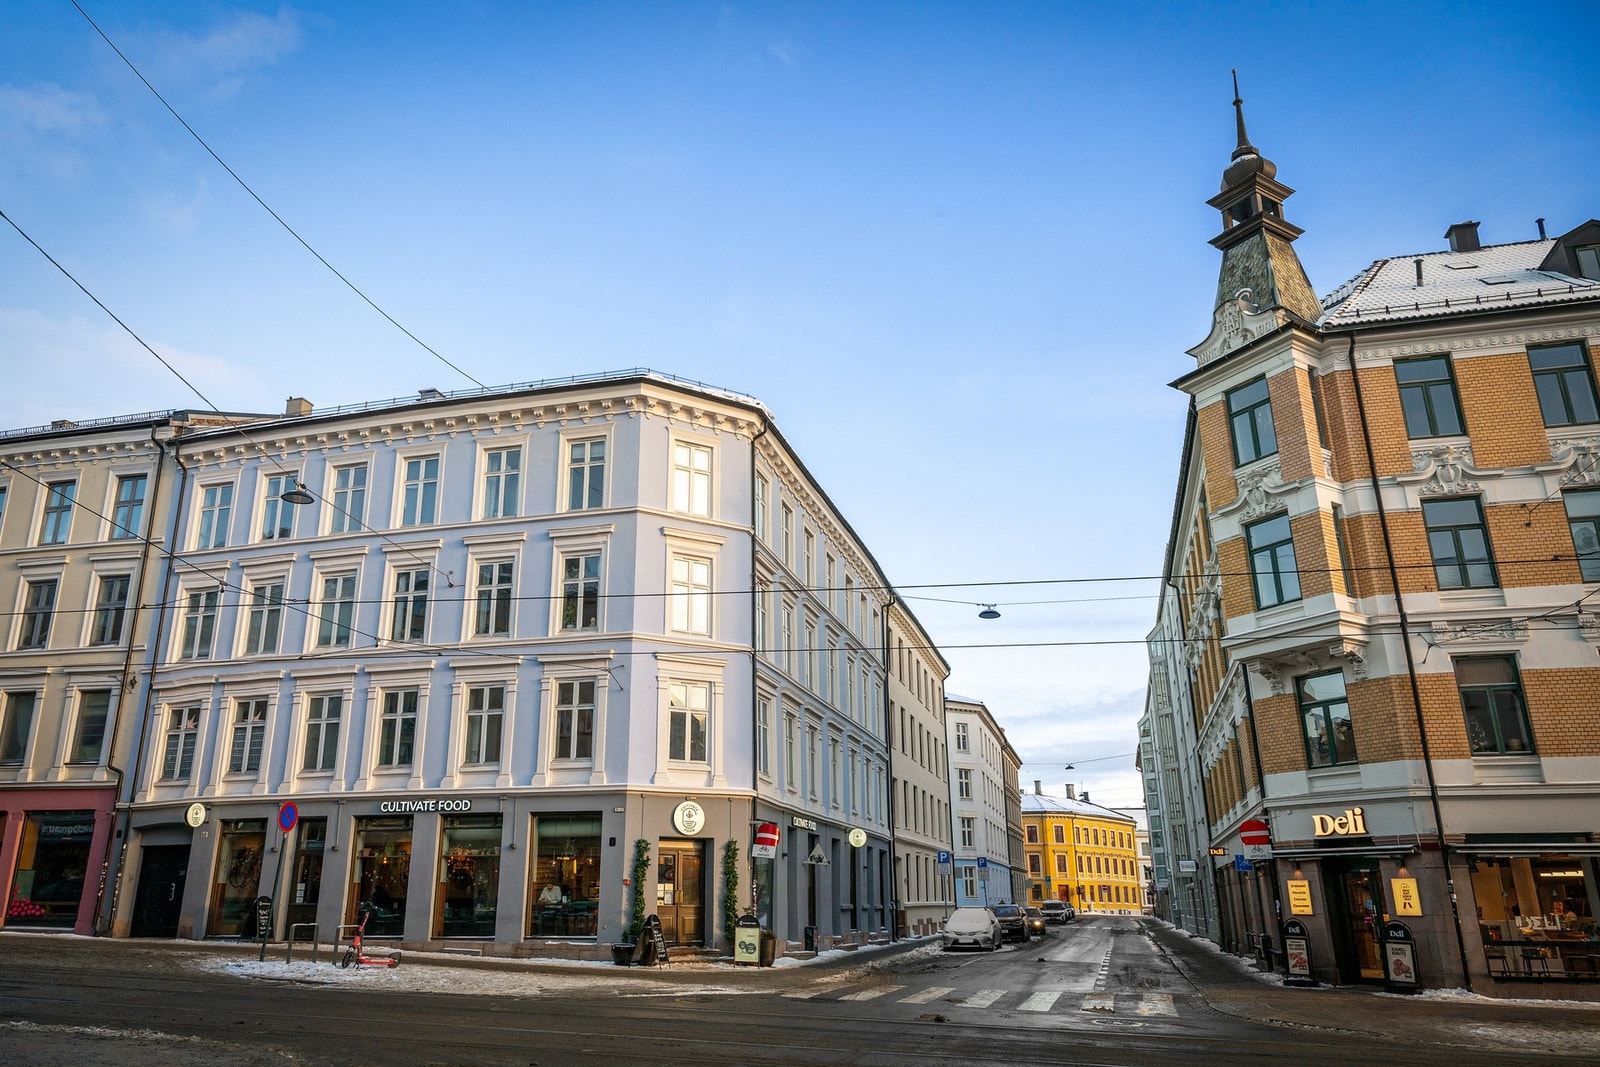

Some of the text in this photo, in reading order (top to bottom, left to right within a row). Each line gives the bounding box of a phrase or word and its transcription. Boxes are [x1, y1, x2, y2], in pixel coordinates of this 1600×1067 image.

[380, 799, 471, 812] CULTIVATE FOOD
[1311, 807, 1367, 836] Deli
[940, 852, 947, 862] P
[979, 858, 985, 866] P
[1389, 930, 1405, 938] Deli
